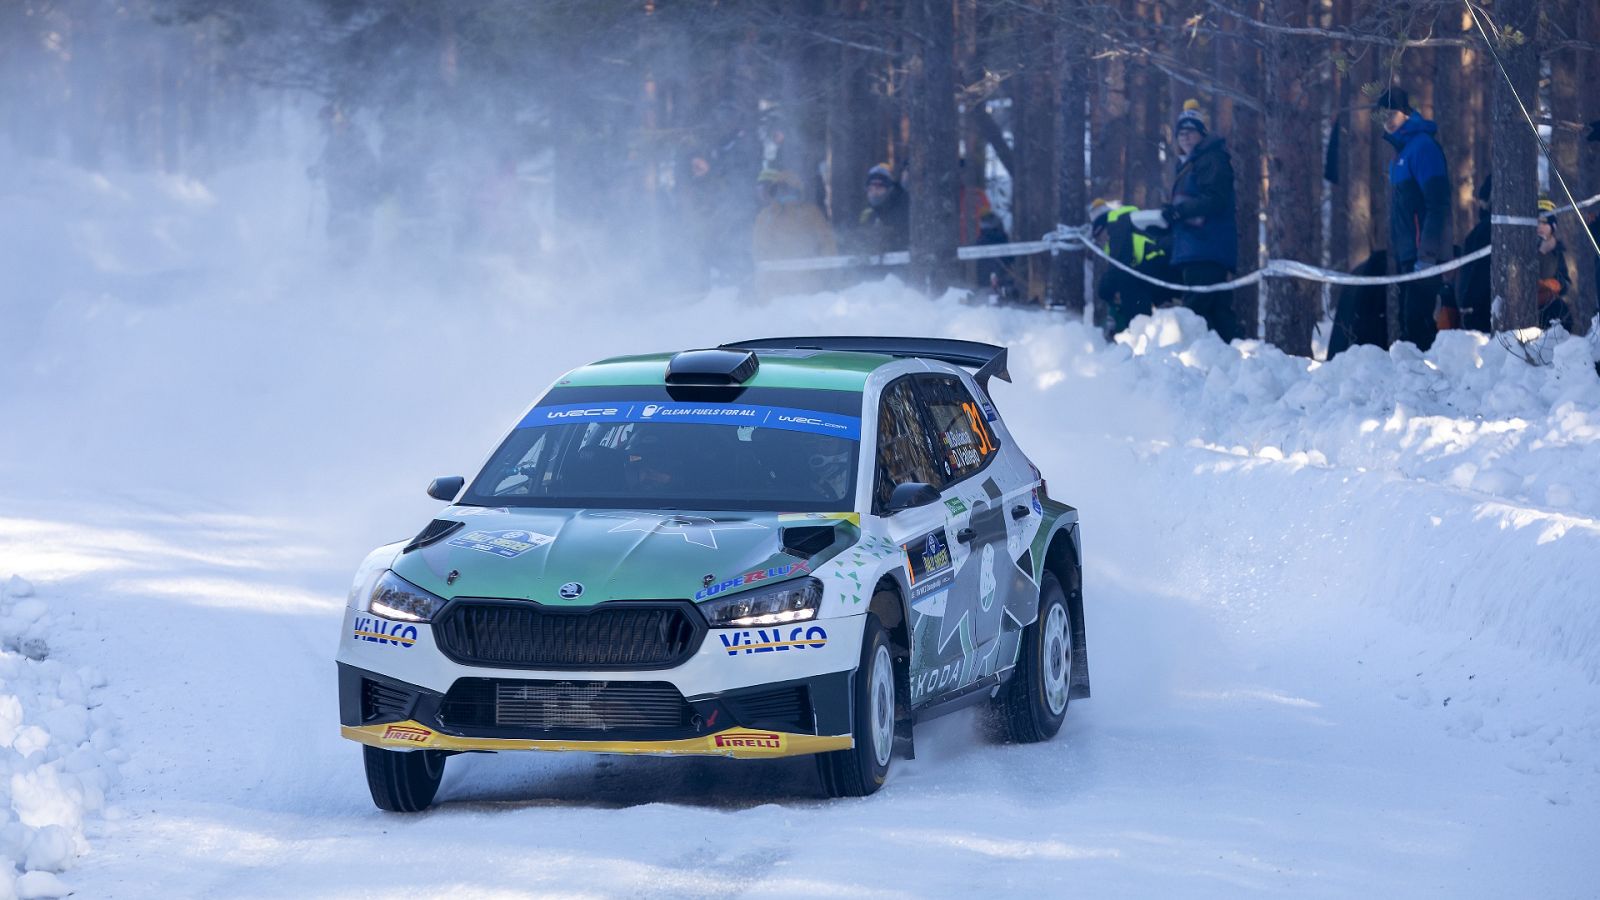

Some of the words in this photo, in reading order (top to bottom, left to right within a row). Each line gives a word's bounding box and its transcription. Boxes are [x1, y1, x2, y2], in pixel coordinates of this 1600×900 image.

[662, 408, 691, 416] CLEAN
[692, 408, 720, 416] FUELS
[739, 409, 756, 417] ALL
[962, 402, 997, 455] 31
[695, 559, 812, 600] COPERLUX
[384, 725, 432, 742] PIRELLI
[713, 733, 780, 748] PIRELLI
